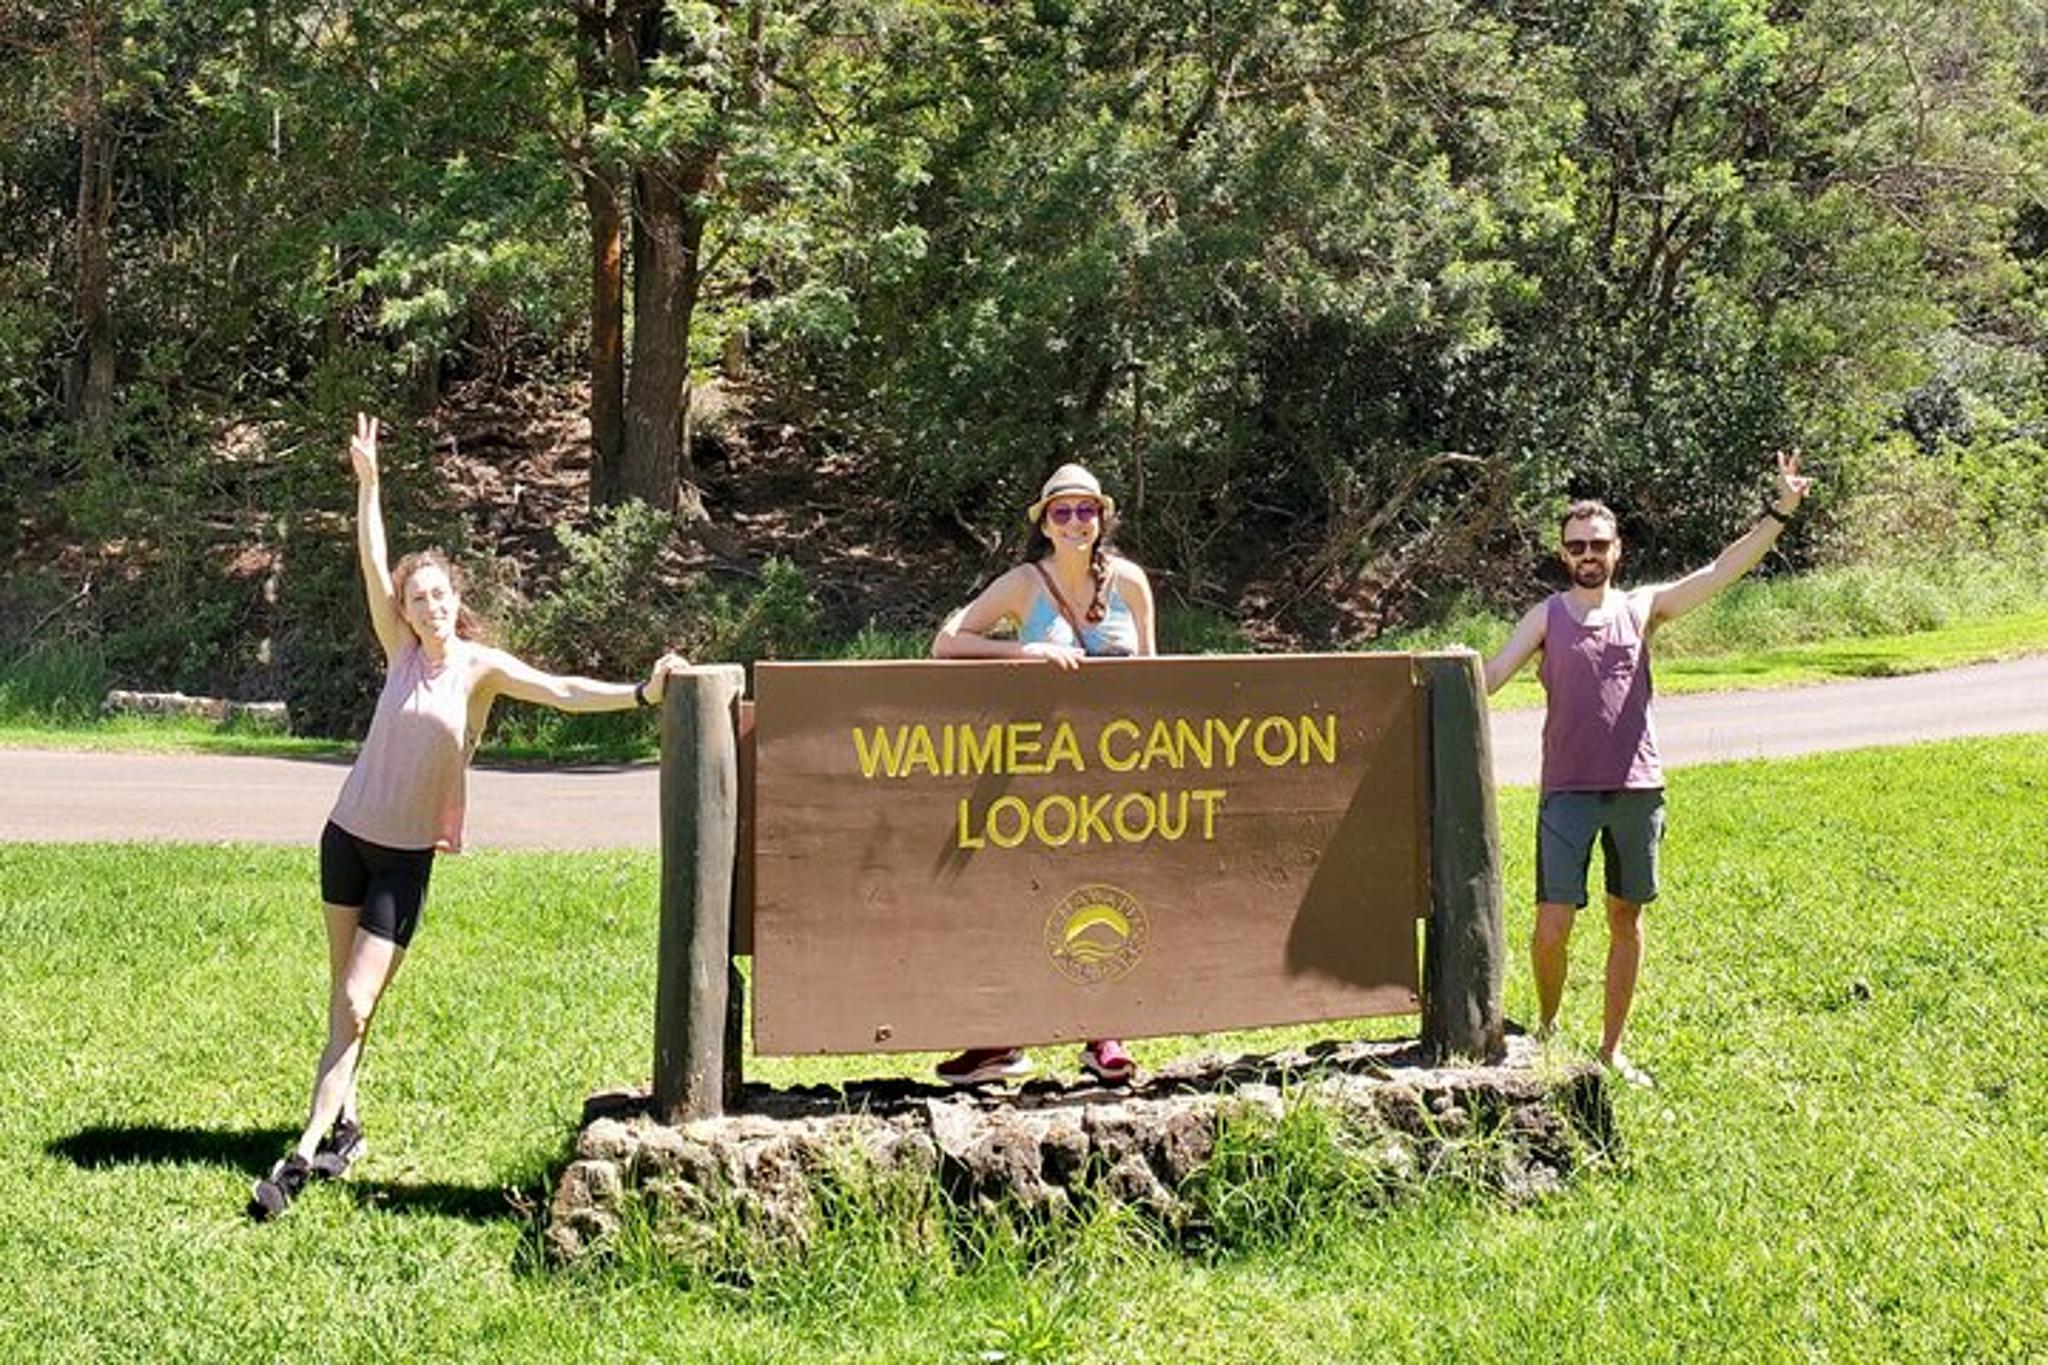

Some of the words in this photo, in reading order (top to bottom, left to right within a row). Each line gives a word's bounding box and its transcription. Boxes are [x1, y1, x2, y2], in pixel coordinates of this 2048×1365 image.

[853, 722, 1083, 776] WAIMEA
[1098, 715, 1338, 771] CANYON
[957, 789, 1226, 848] LOOKOUT
